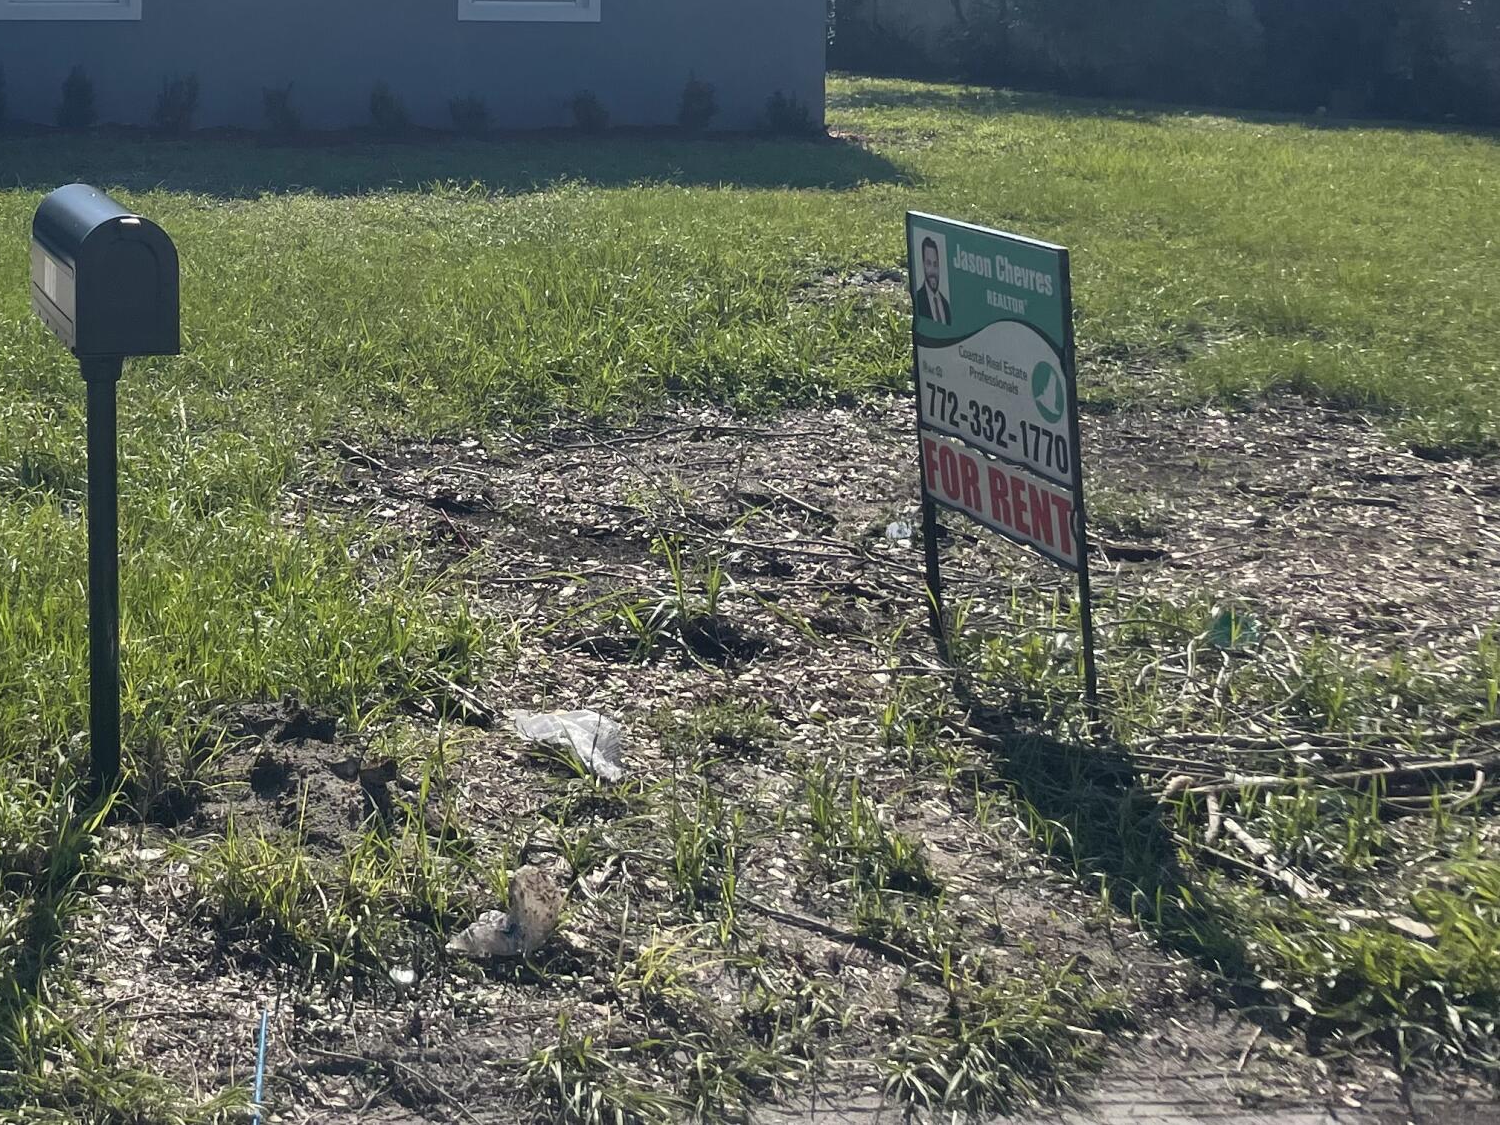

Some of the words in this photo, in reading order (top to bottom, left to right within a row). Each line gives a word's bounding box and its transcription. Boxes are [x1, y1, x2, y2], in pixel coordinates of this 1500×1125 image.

[953, 244, 992, 278] Jason
[995, 254, 1053, 296] Chevres
[958, 345, 985, 365] Coastal
[986, 354, 1001, 370] Real
[1003, 361, 1028, 382] Estate
[969, 366, 1019, 395] Professionals
[926, 381, 1069, 475] 772-332-1770
[923, 437, 982, 513] FOR
[987, 465, 1073, 556] RENT
